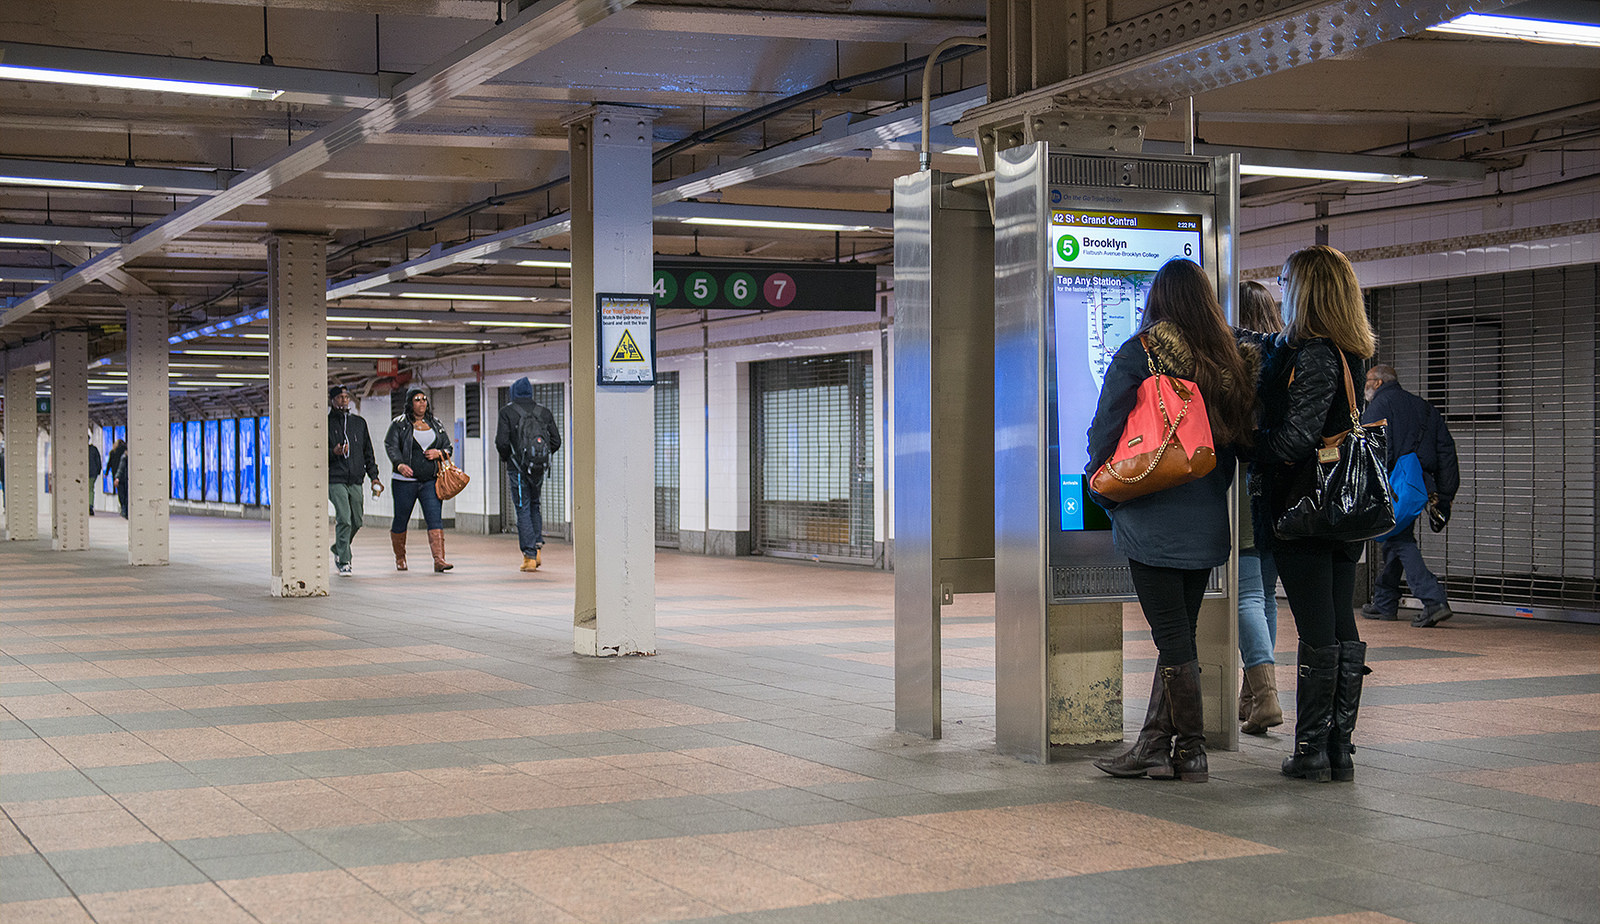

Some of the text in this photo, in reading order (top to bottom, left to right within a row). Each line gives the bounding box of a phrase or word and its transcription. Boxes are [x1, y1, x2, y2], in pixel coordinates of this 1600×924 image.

[1053, 213, 1064, 223] 42
[1065, 213, 1075, 224] St
[1081, 214, 1107, 225] Grand
[1108, 215, 1137, 226] Central
[1062, 239, 1074, 256] 5
[1083, 237, 1127, 250] Brooklyn
[1183, 243, 1192, 257] 6
[1142, 251, 1160, 259] College
[1057, 275, 1122, 287] Tap Any Station
[653, 278, 787, 300] 4 5 6 7
